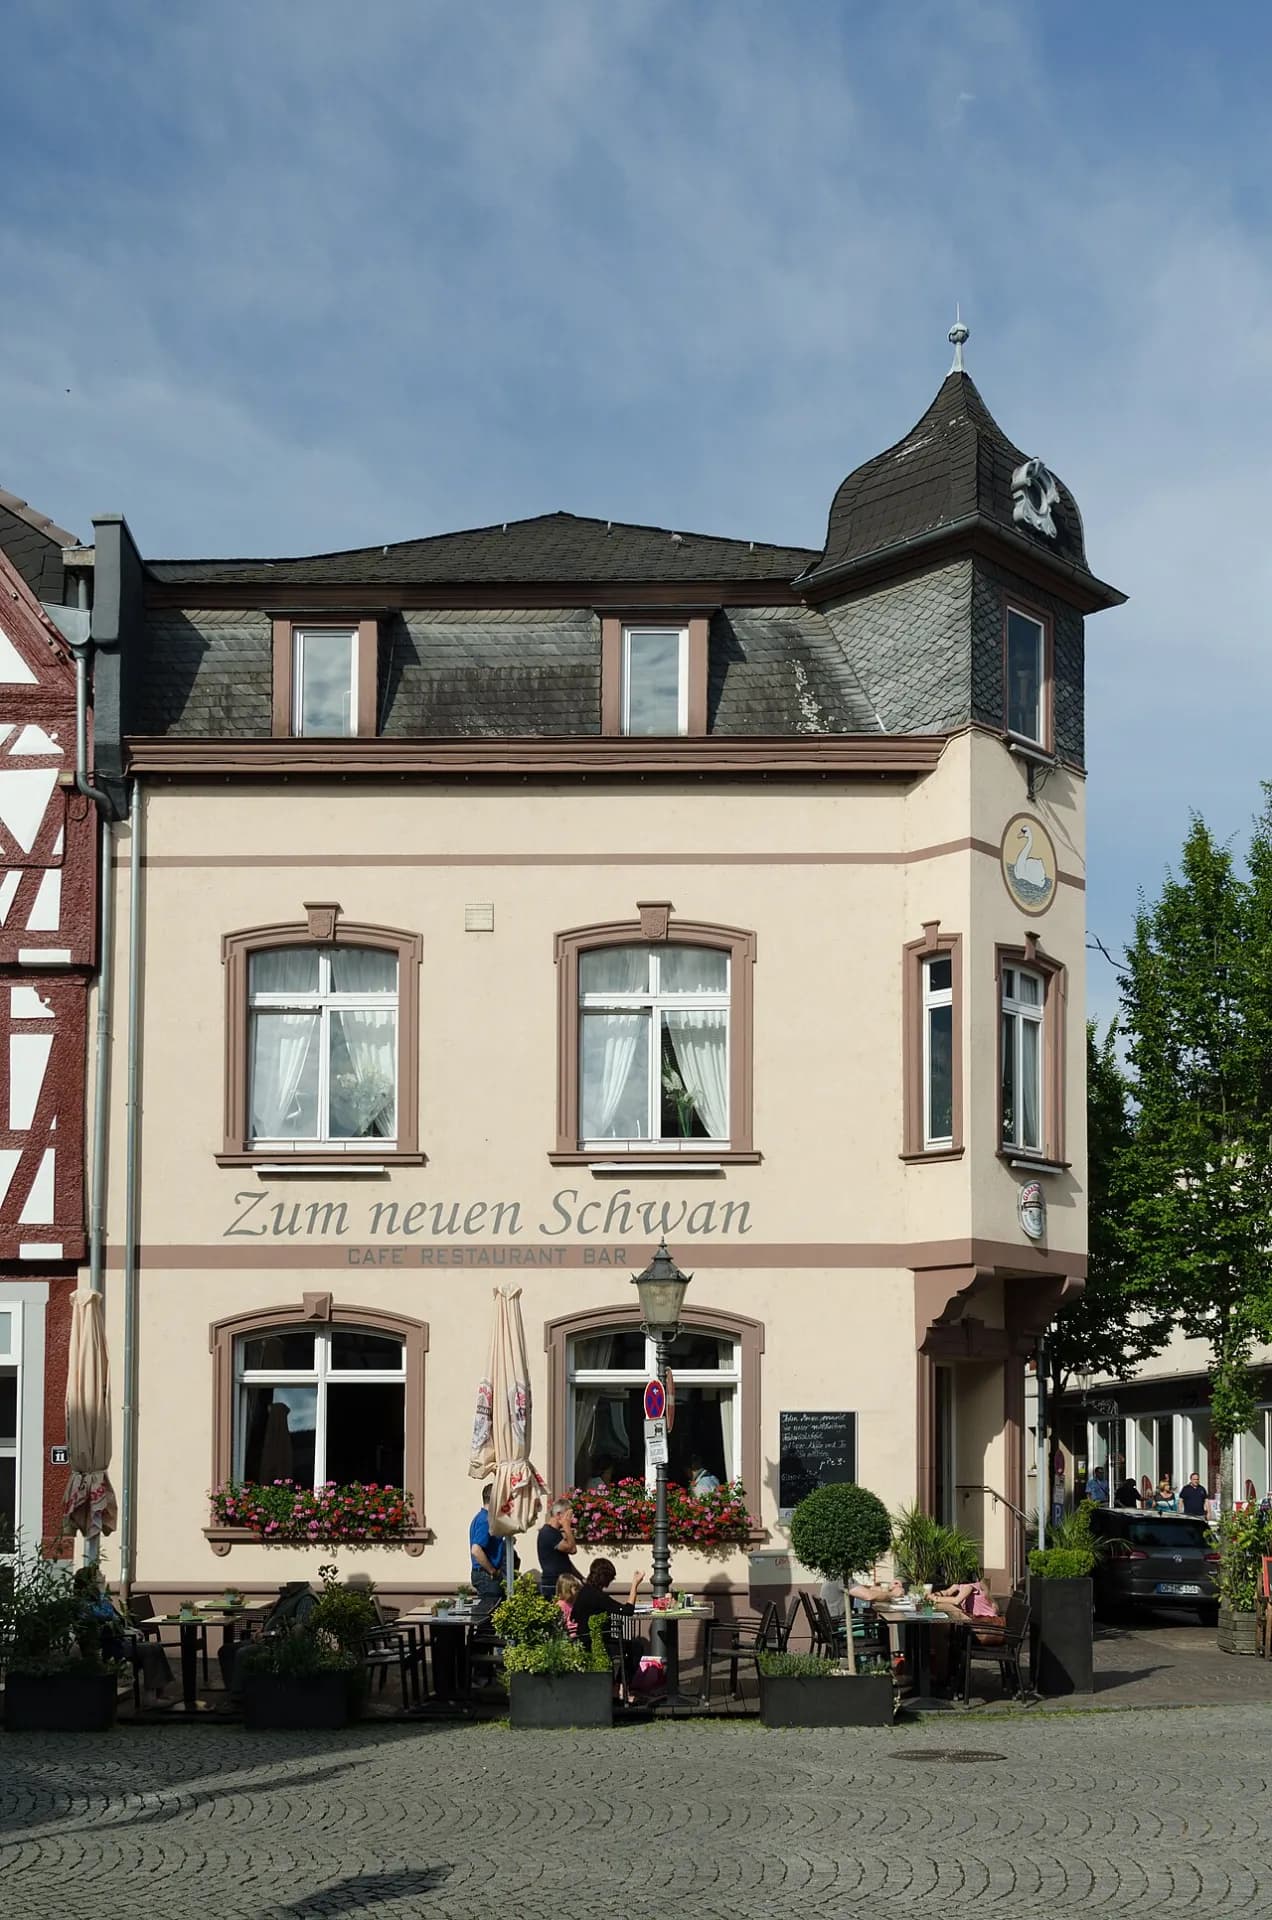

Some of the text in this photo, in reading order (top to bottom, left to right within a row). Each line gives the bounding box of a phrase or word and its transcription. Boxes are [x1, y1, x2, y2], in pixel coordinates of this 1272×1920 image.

[222, 1189, 753, 1237] Zum neuen Schwan
[420, 1247, 567, 1265] RESTAURANT
[583, 1247, 627, 1265] BAR
